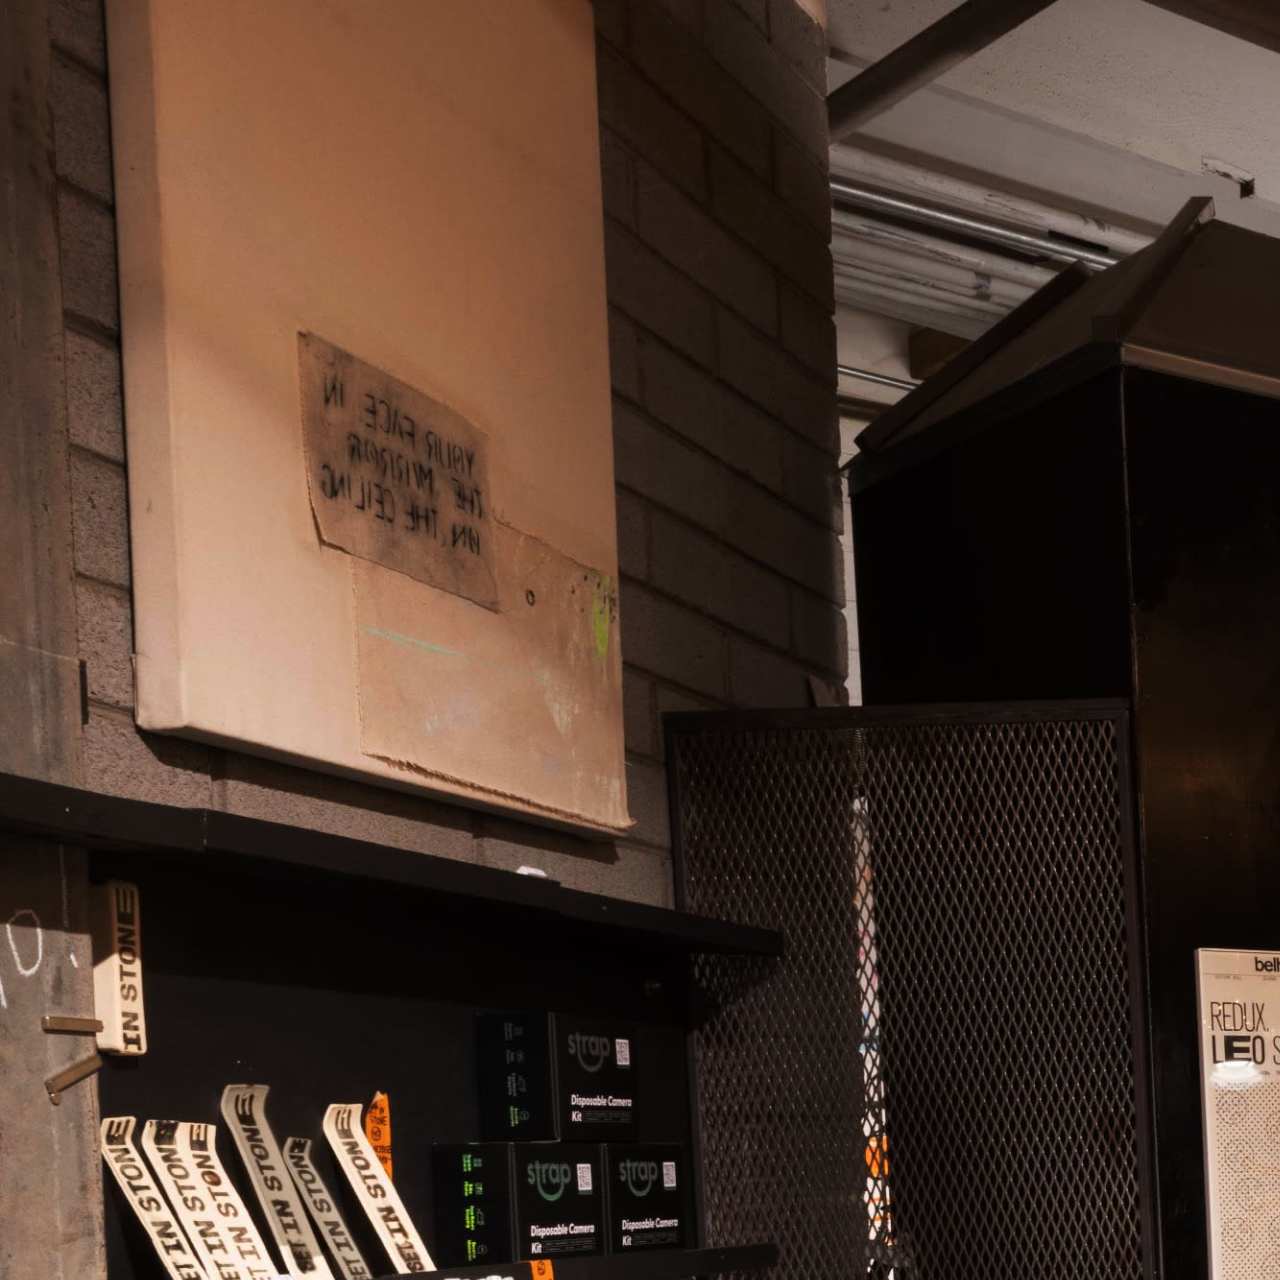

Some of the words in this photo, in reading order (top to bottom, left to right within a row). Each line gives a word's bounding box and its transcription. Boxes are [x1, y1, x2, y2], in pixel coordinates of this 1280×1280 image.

[116, 887, 138, 1002] STONE
[121, 1011, 142, 1051] IN
[567, 1031, 610, 1059] strap
[1211, 1034, 1265, 1065] LEO
[570, 1094, 606, 1108] Disposable
[607, 1095, 632, 1107] Camera
[571, 1111, 583, 1122] Kit
[234, 1094, 282, 1191] STONE
[334, 1108, 386, 1199] STONE
[105, 1119, 161, 1213] STONE
[153, 1120, 205, 1212] STON
[189, 1124, 238, 1217] STONE
[289, 1138, 332, 1214] STONE
[527, 1160, 571, 1187] strap
[619, 1159, 658, 1184] strap
[272, 1199, 301, 1235] IN
[376, 1206, 409, 1240] IN
[530, 1224, 567, 1238] Disposable
[569, 1224, 595, 1234] Camera
[621, 1218, 652, 1232] Disposable
[653, 1218, 679, 1228] Camera
[151, 1220, 187, 1256] IN
[193, 1220, 228, 1255] IN
[228, 1226, 261, 1260] IN
[323, 1221, 355, 1252] IN
[531, 1242, 542, 1254] Kit
[622, 1235, 632, 1247] Kit
